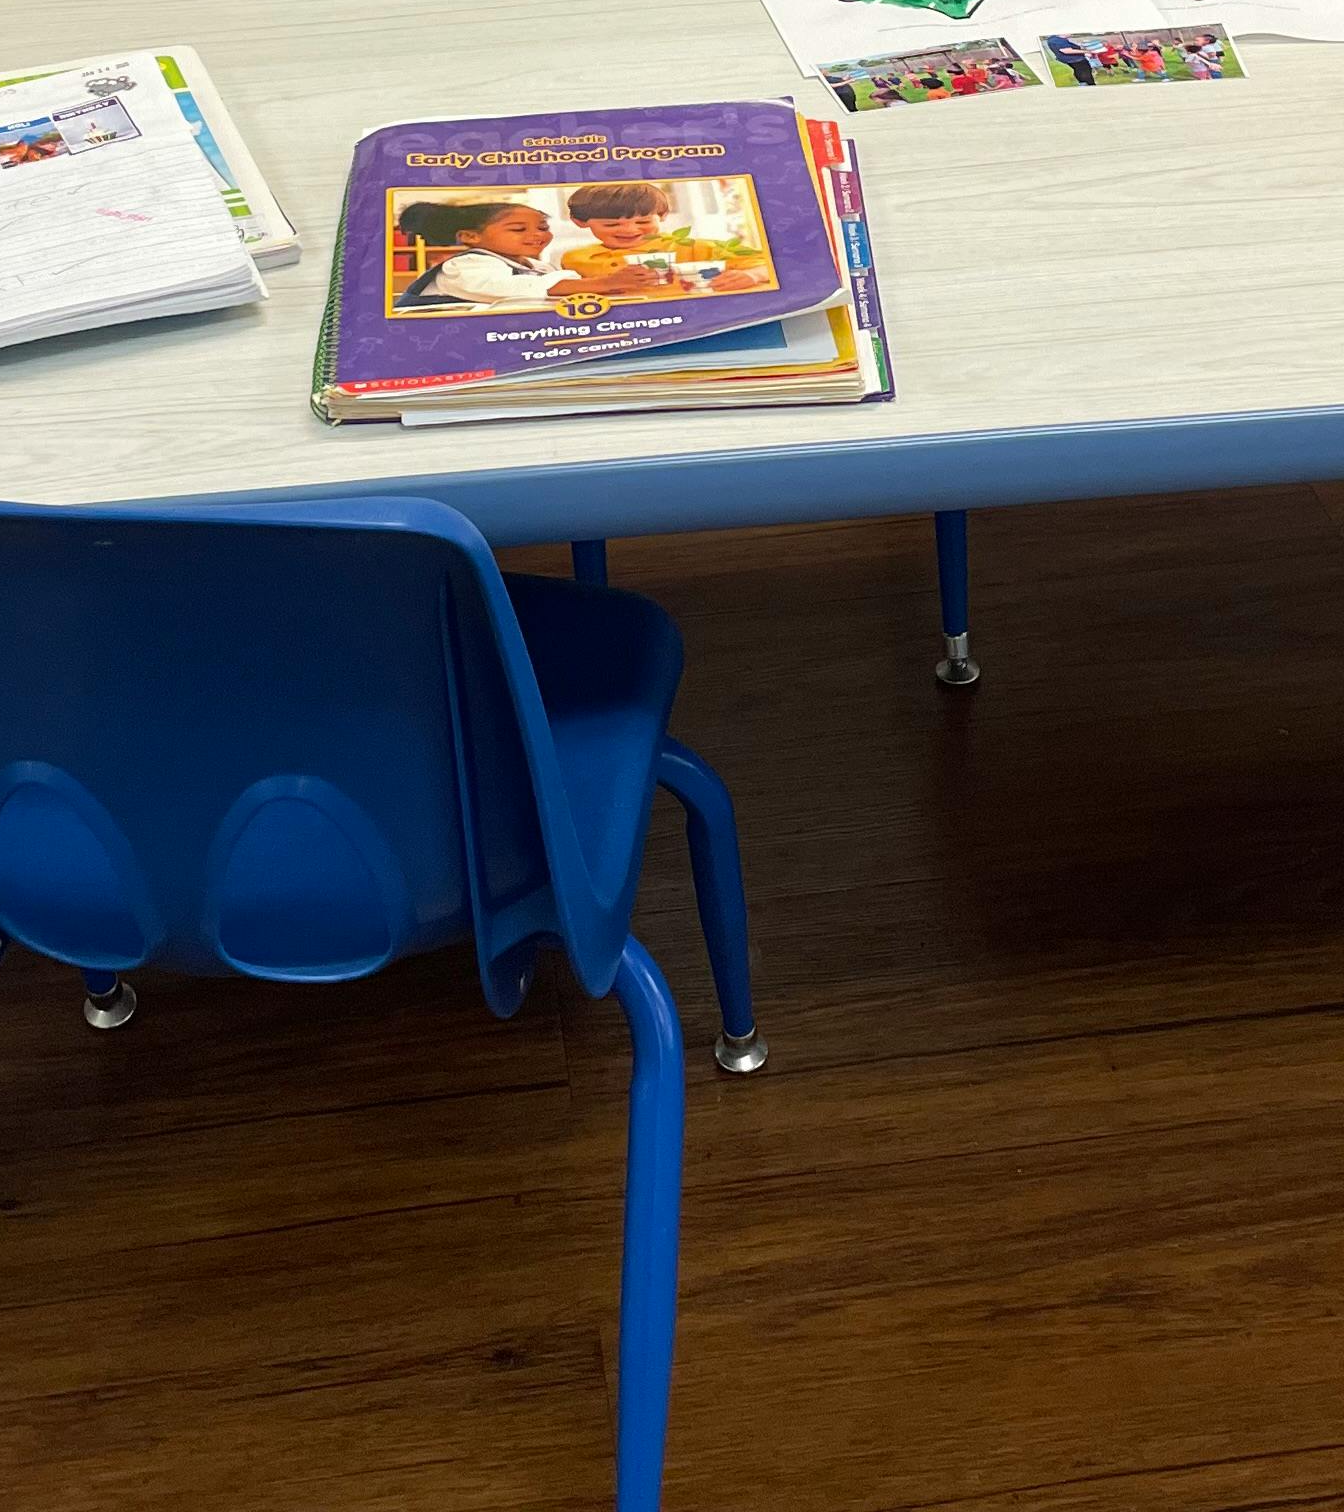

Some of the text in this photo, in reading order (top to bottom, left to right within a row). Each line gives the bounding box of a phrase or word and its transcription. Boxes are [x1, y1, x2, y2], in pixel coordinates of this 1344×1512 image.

[522, 133, 607, 148] Scholastic
[406, 143, 725, 169] Early Childhood Program
[562, 300, 603, 318] 10
[485, 315, 684, 343] Everything Changes
[522, 335, 652, 362] Todo cambia
[370, 370, 487, 388] SCHOLASTIC
